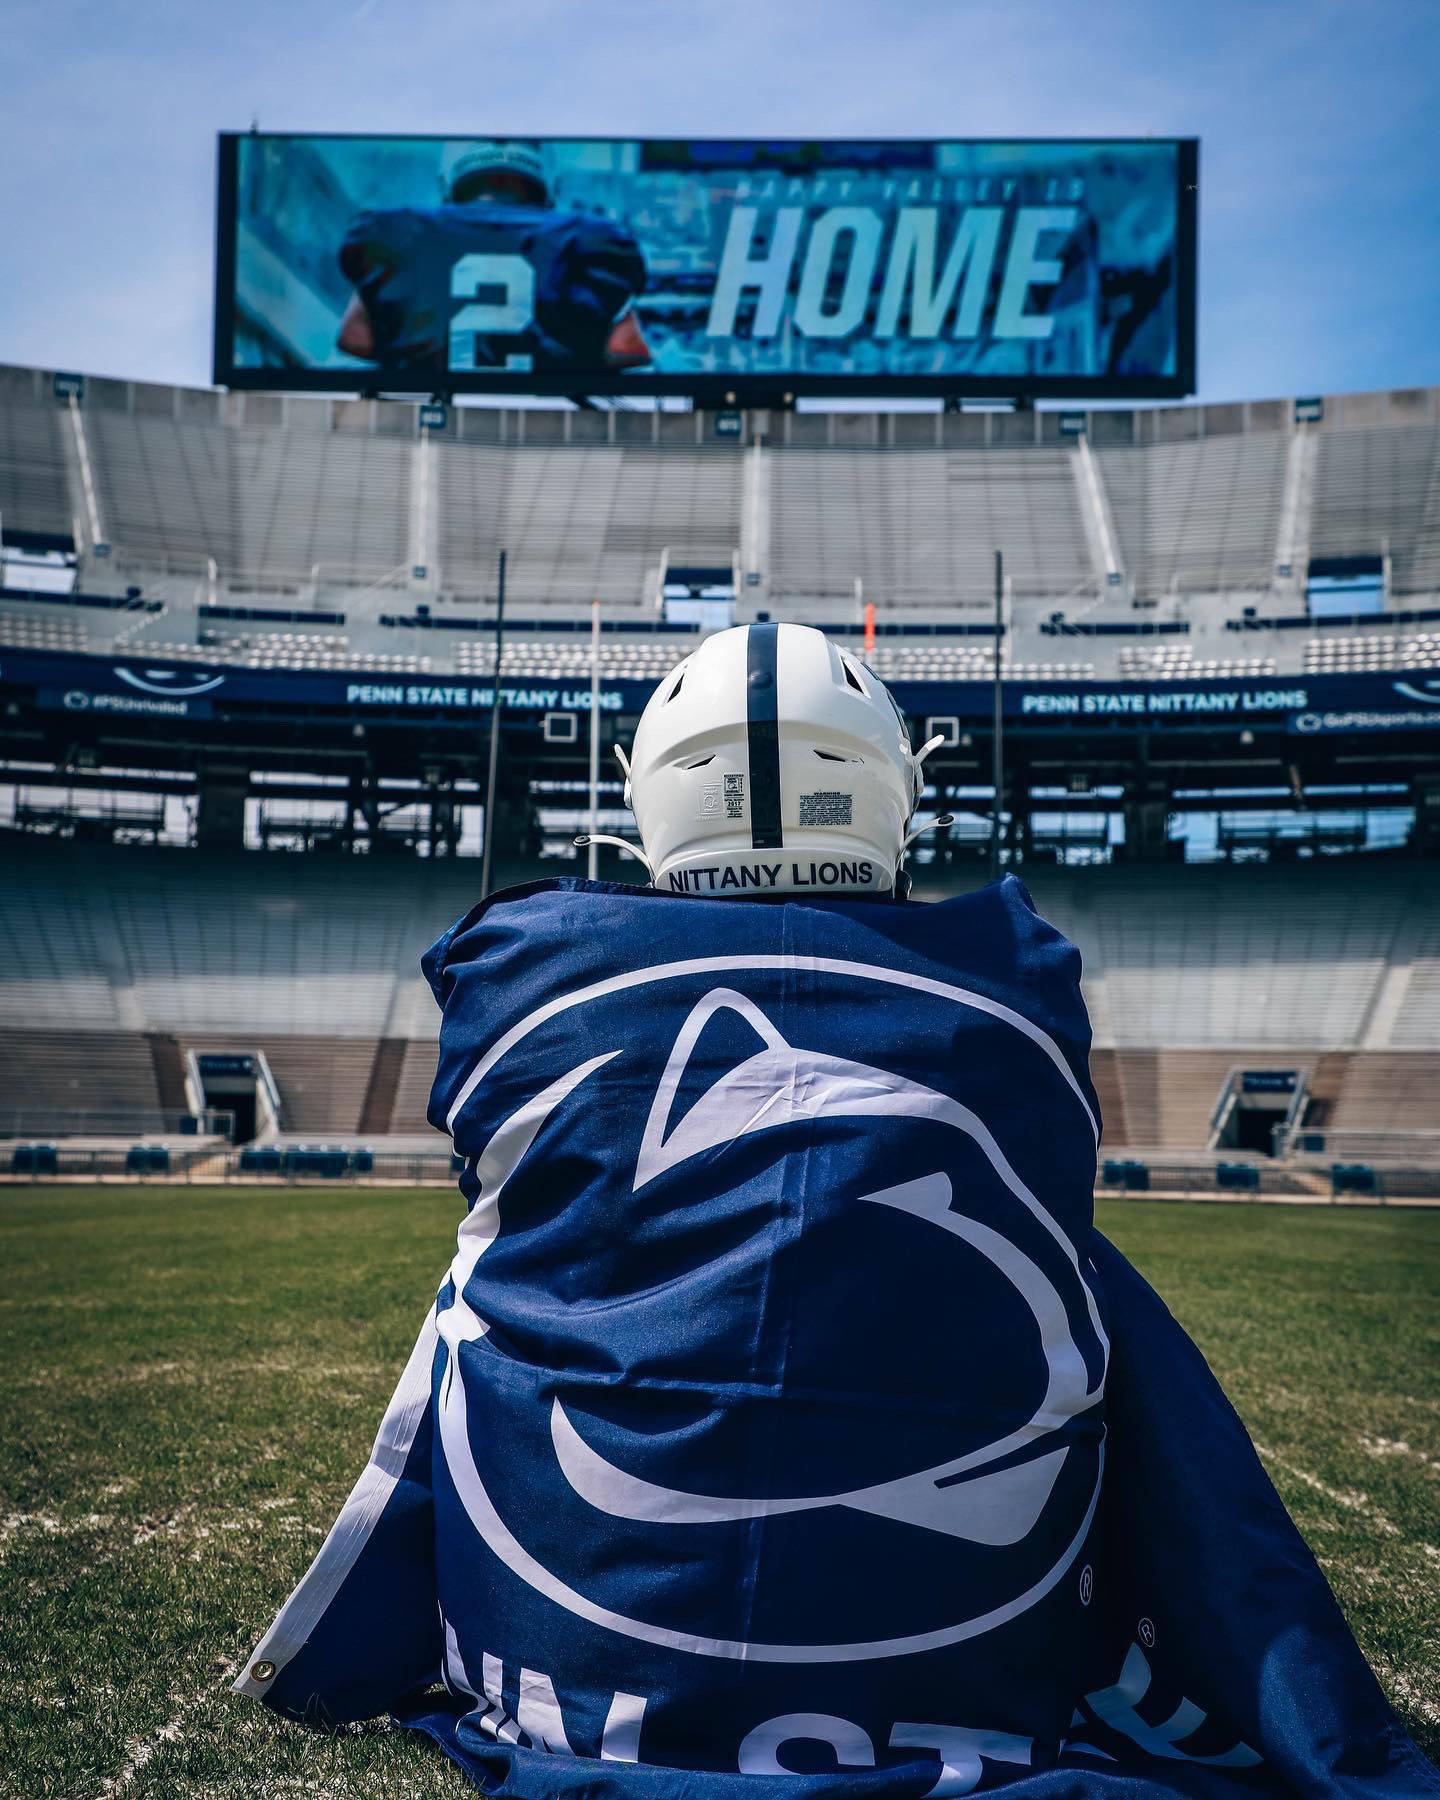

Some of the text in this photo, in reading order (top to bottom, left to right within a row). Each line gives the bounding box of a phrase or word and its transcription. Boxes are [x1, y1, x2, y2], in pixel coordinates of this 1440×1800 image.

[705, 206, 1078, 339] HOME
[448, 253, 536, 373] 2
[347, 684, 403, 703] PENN
[406, 686, 467, 705] STATE
[471, 688, 559, 708] NITANY
[1023, 690, 1307, 713] PENN STATE NITTANY LIONS
[668, 862, 873, 893] NITTANY LIONS
